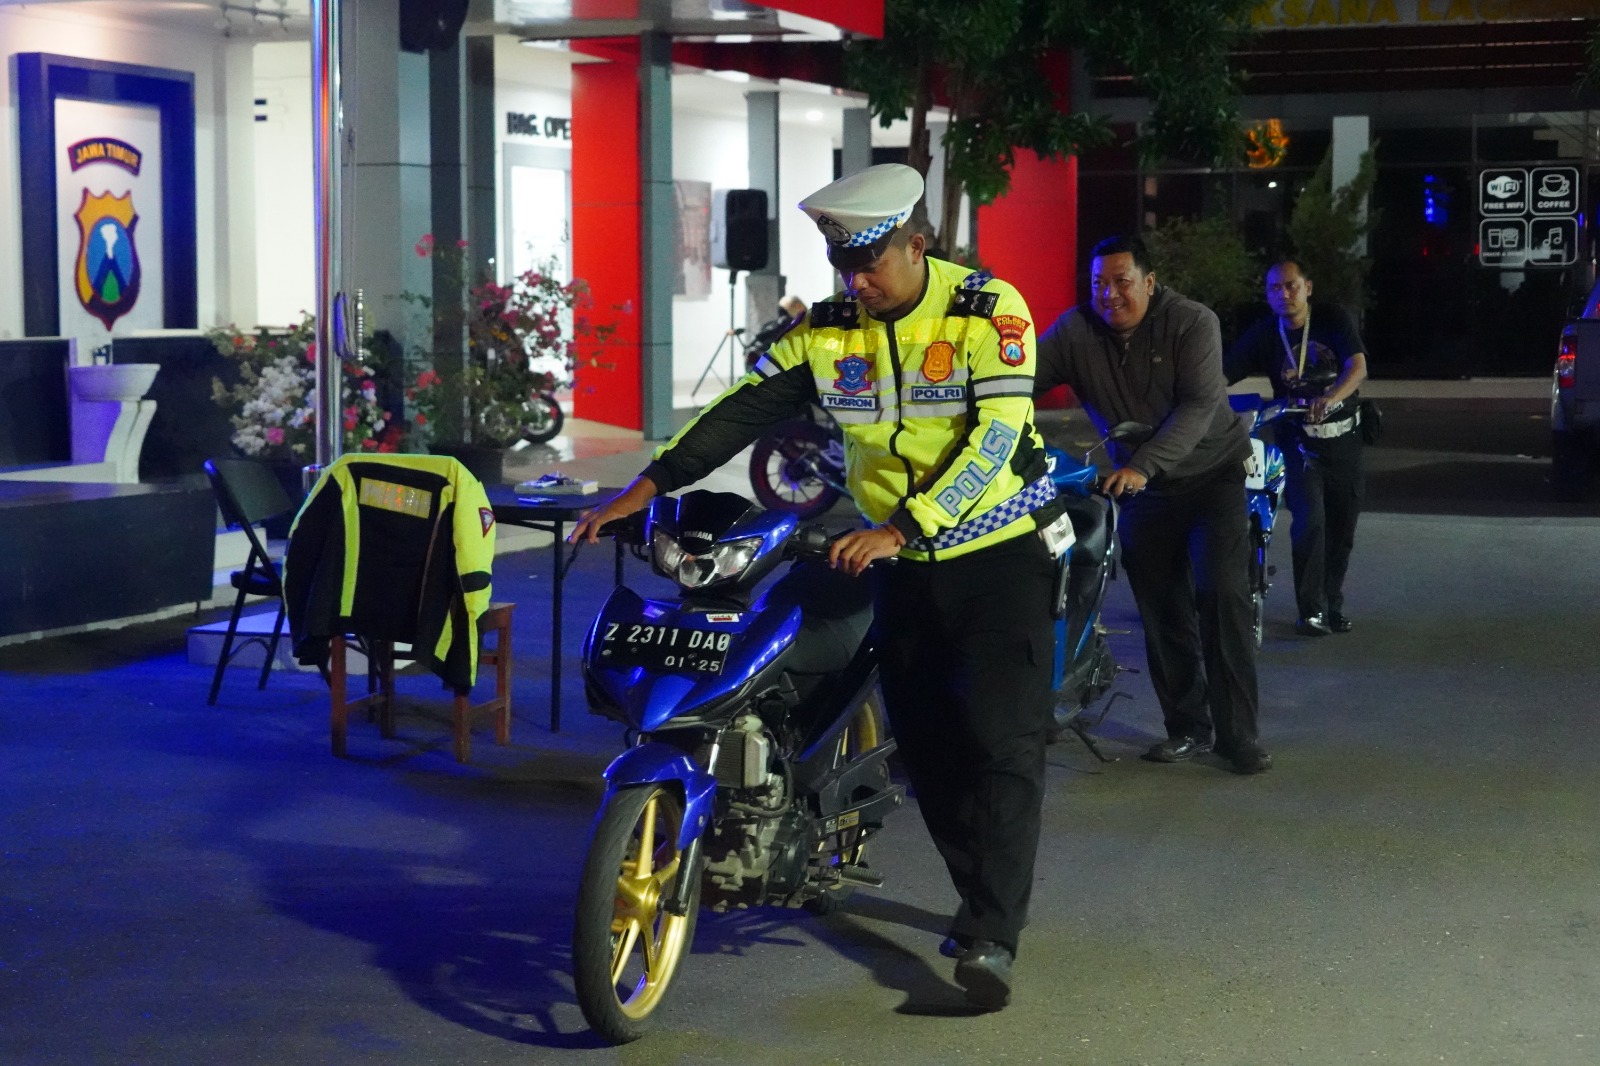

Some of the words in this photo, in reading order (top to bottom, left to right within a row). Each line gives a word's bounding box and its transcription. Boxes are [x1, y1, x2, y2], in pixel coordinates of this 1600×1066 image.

[76, 142, 105, 165] JAWA
[105, 142, 138, 168] TIMUR
[1537, 200, 1571, 209] COFFEE
[914, 388, 960, 399] POLRI
[934, 418, 1018, 517] POLISI
[683, 530, 713, 541] YAMAHA
[603, 622, 620, 641] Z
[626, 624, 680, 647] 2311
